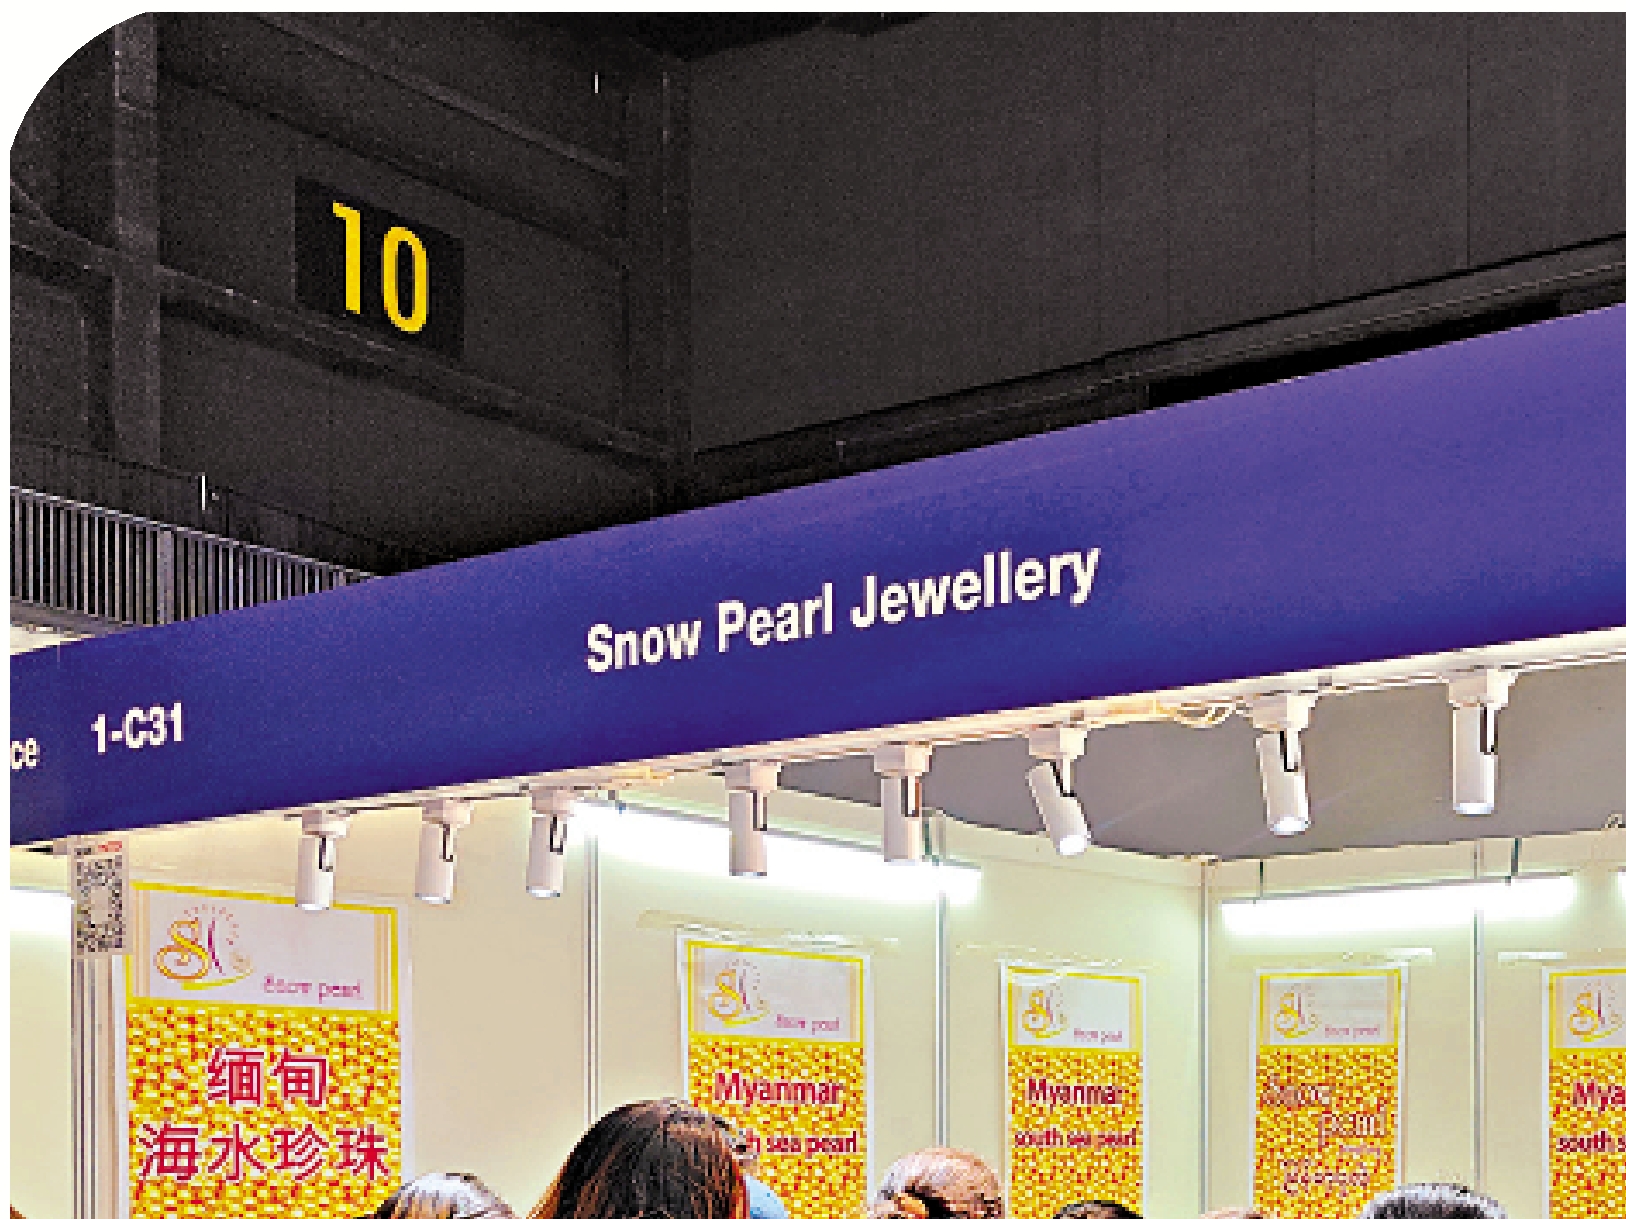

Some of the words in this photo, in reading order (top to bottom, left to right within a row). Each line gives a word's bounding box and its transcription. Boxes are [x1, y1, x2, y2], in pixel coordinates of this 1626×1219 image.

[332, 200, 430, 333] 10
[586, 621, 703, 673] Snow
[716, 581, 834, 653] Pearl
[850, 546, 1102, 628] Jewellery
[91, 700, 185, 755] 1-C31
[207, 1047, 328, 1107] 缅甸
[714, 1072, 845, 1109] Myanmar
[1027, 1077, 1127, 1111] Myanmar
[137, 1121, 391, 1181] 海水珍珠
[766, 1137, 802, 1154] sea
[806, 1130, 858, 1159] pearl
[1014, 1127, 1064, 1147] south
[1556, 1130, 1613, 1153] south
